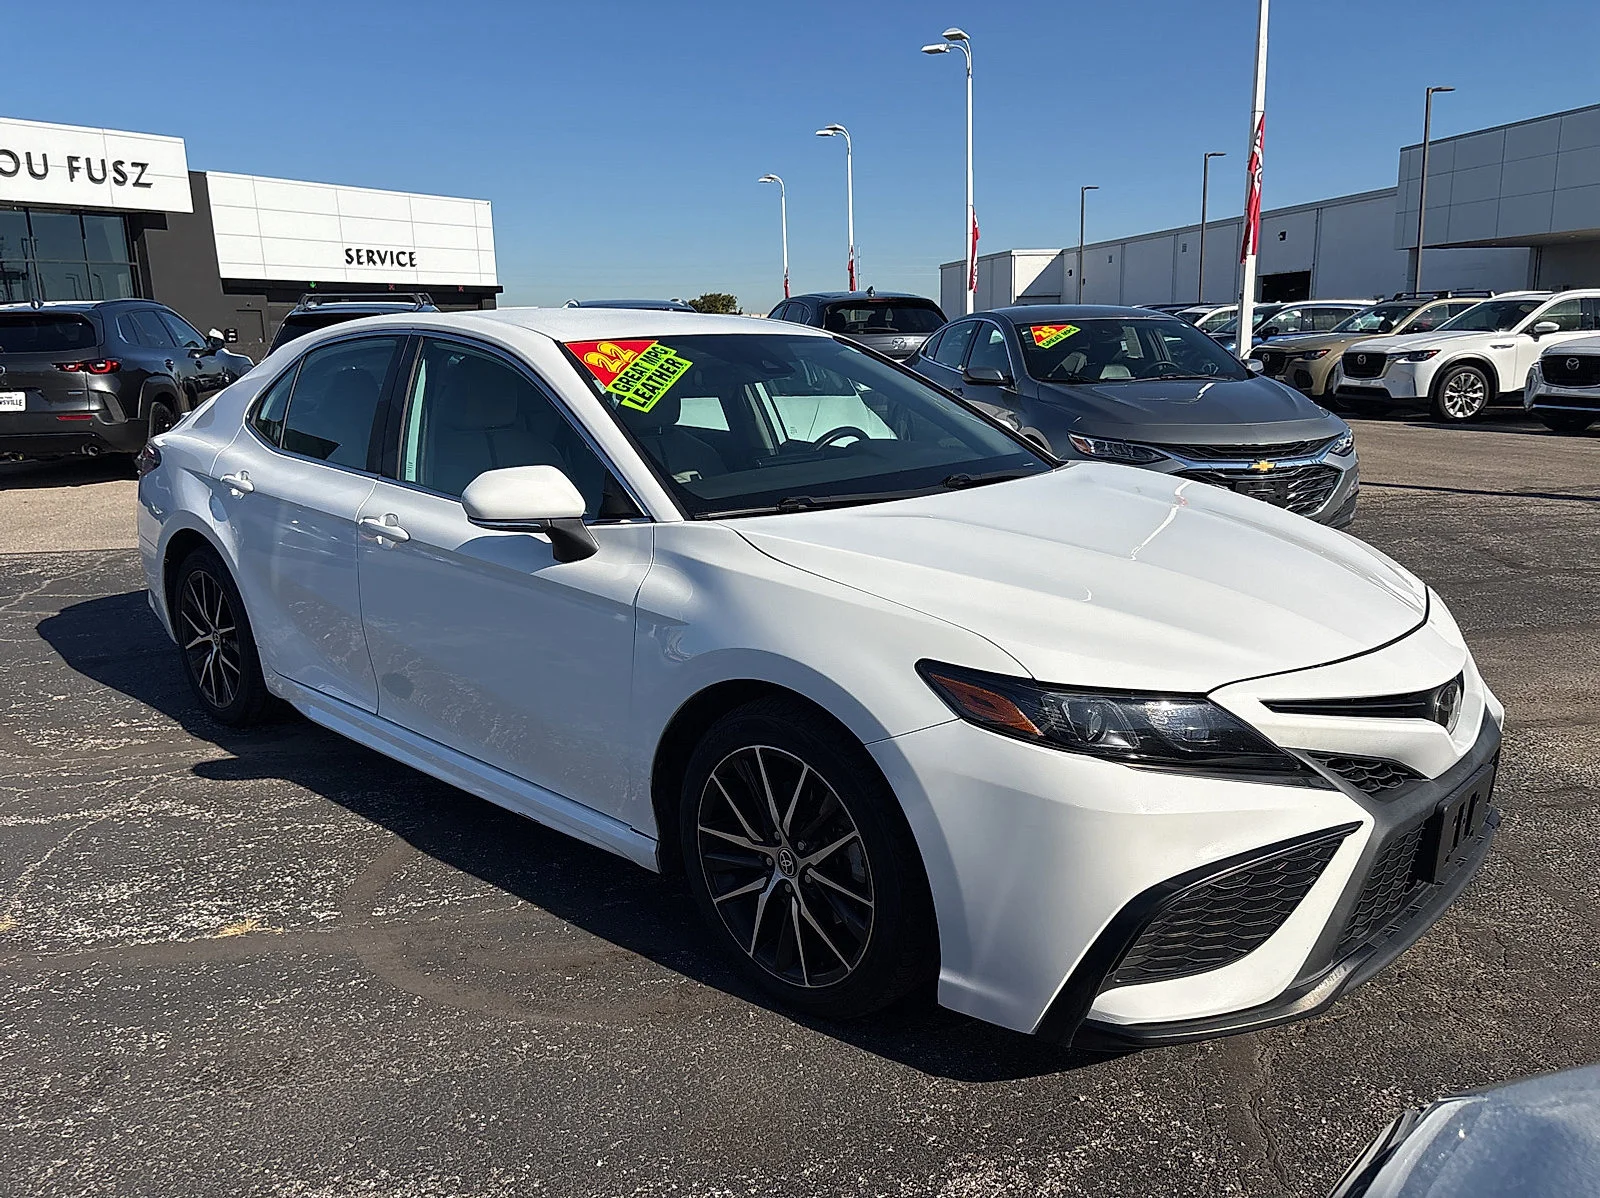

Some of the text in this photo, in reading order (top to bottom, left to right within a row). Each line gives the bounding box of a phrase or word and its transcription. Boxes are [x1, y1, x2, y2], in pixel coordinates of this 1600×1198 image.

[67, 156, 153, 188] FUSZ
[345, 248, 417, 267] SERVICE
[584, 342, 638, 373] 22
[612, 346, 668, 393] GREAT MPG
[627, 358, 684, 408] LEATHER
